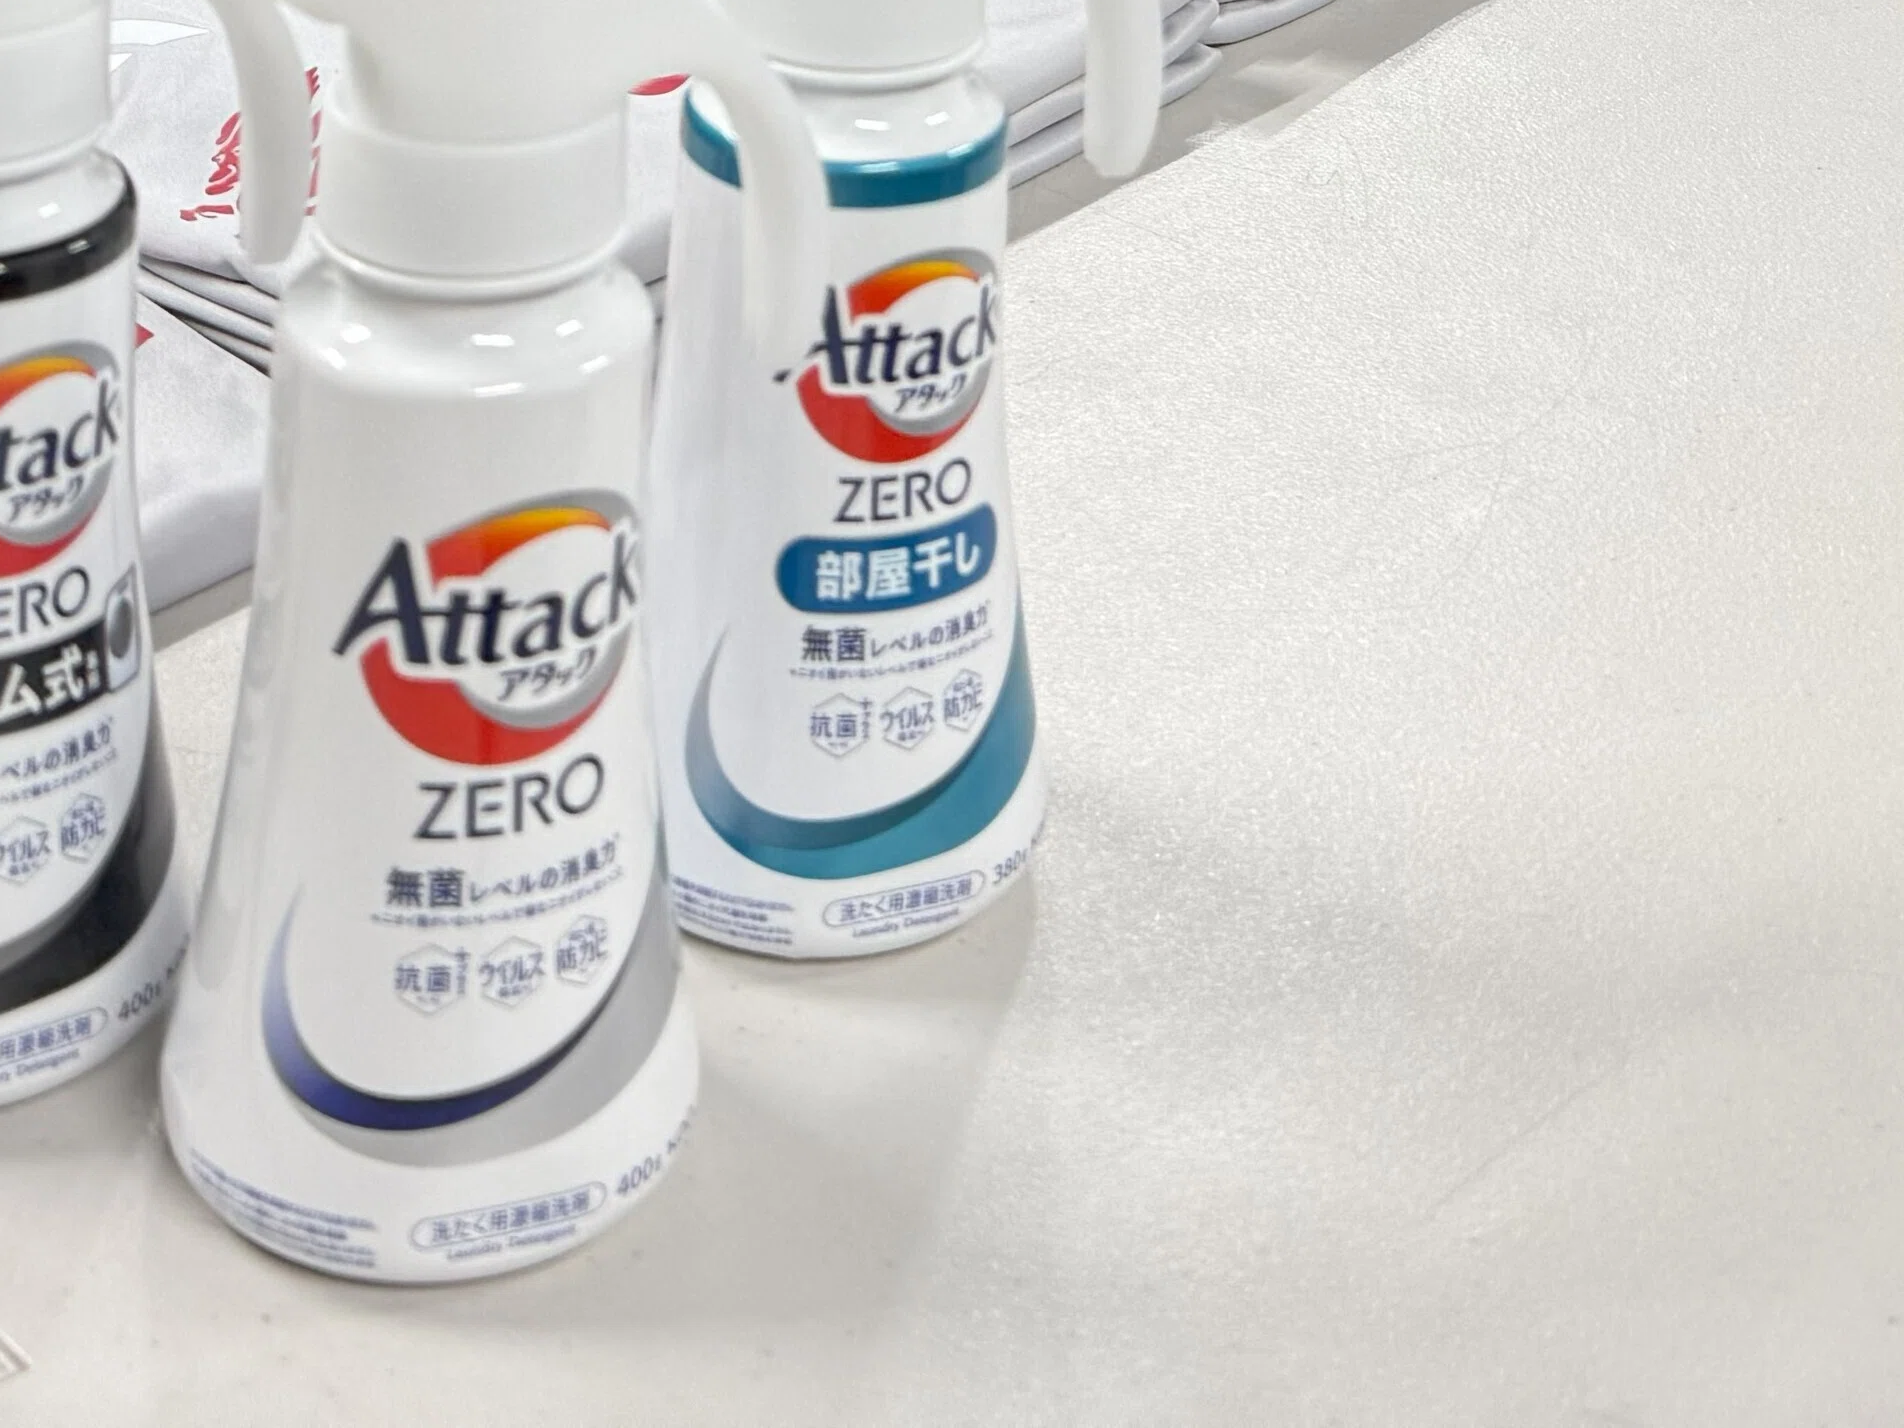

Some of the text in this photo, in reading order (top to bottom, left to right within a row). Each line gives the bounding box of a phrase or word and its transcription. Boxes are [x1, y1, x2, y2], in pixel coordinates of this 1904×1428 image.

[772, 282, 997, 386] Attack
[895, 375, 966, 412] アタック
[8, 477, 83, 523] アタック
[833, 457, 972, 523] ZERO
[332, 528, 637, 666] Attack
[815, 532, 980, 602] 部屋干し
[498, 647, 595, 702] アタック
[810, 713, 858, 738] 抗菌
[413, 753, 605, 841] ZERO
[395, 964, 452, 993] 抗菌
